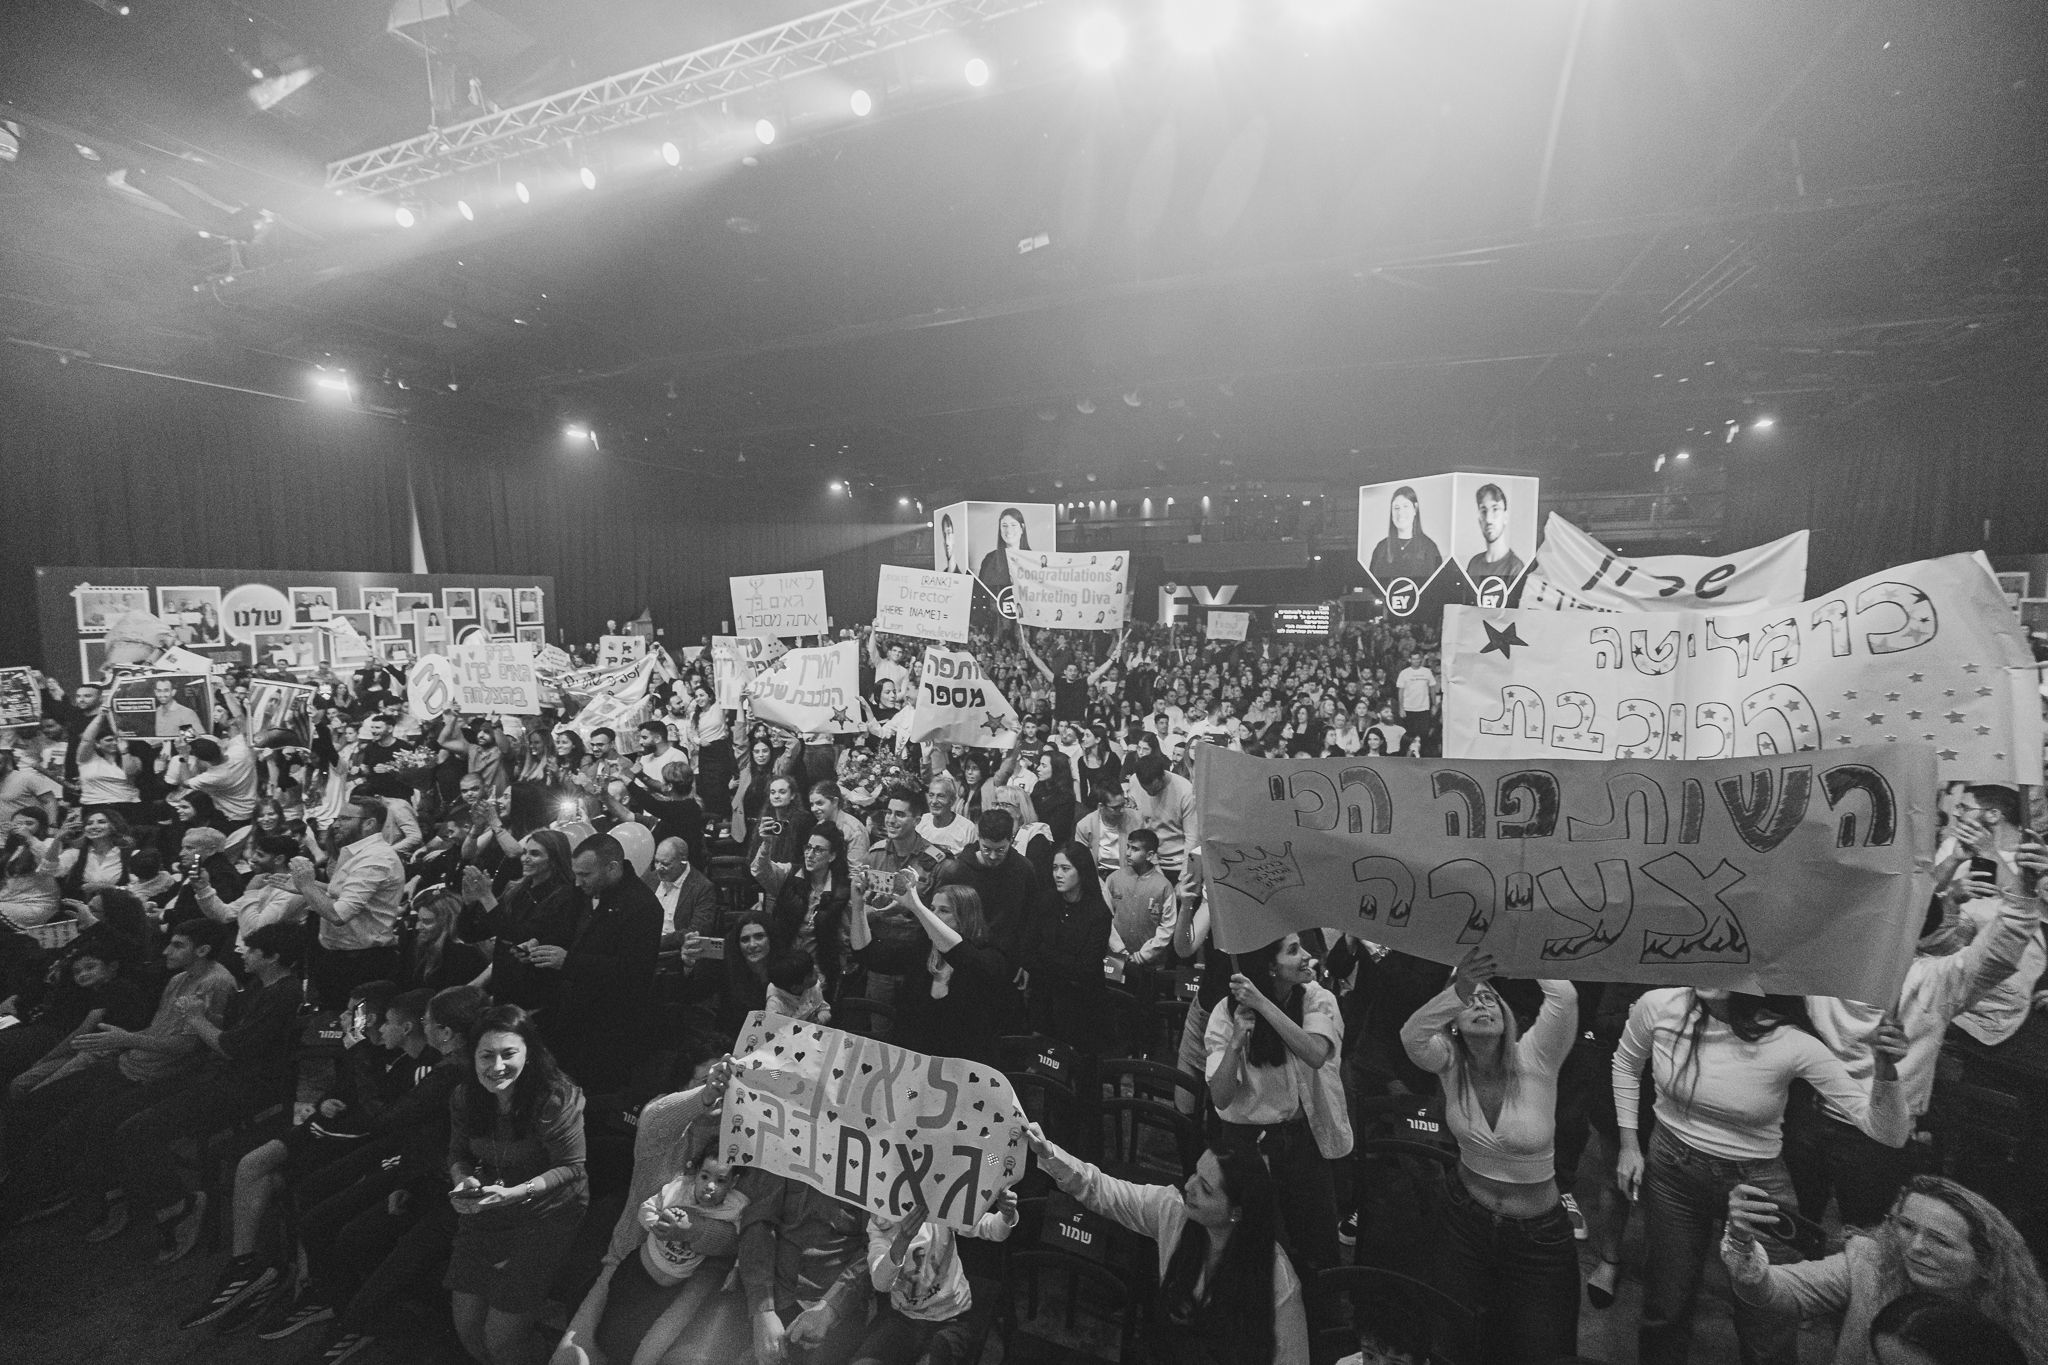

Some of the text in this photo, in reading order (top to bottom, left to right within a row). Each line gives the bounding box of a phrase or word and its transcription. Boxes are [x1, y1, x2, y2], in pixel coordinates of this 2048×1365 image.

[1016, 566, 1112, 584] Congratulations
[899, 585, 952, 604] Director
[1017, 587, 1111, 607] Marketing Diva
[1391, 595, 1410, 609] EY
[1482, 594, 1500, 608] EY
[233, 607, 282, 627] שלנו
[737, 613, 818, 630] אתה מספר 1
[927, 654, 985, 681] ותפה
[463, 685, 528, 708] בהצלחה
[924, 682, 986, 709] מספר
[1479, 684, 1822, 760] הכוכבת
[1268, 763, 1897, 854] השותפה הכי
[1352, 851, 1750, 965] צעירה
[1185, 983, 1200, 992] מור
[1037, 1053, 1060, 1070] שמור
[622, 1111, 636, 1126] מור
[1406, 1118, 1439, 1133] שמור
[755, 1094, 984, 1226] גאים בך
[1059, 1222, 1093, 1245] שמור
